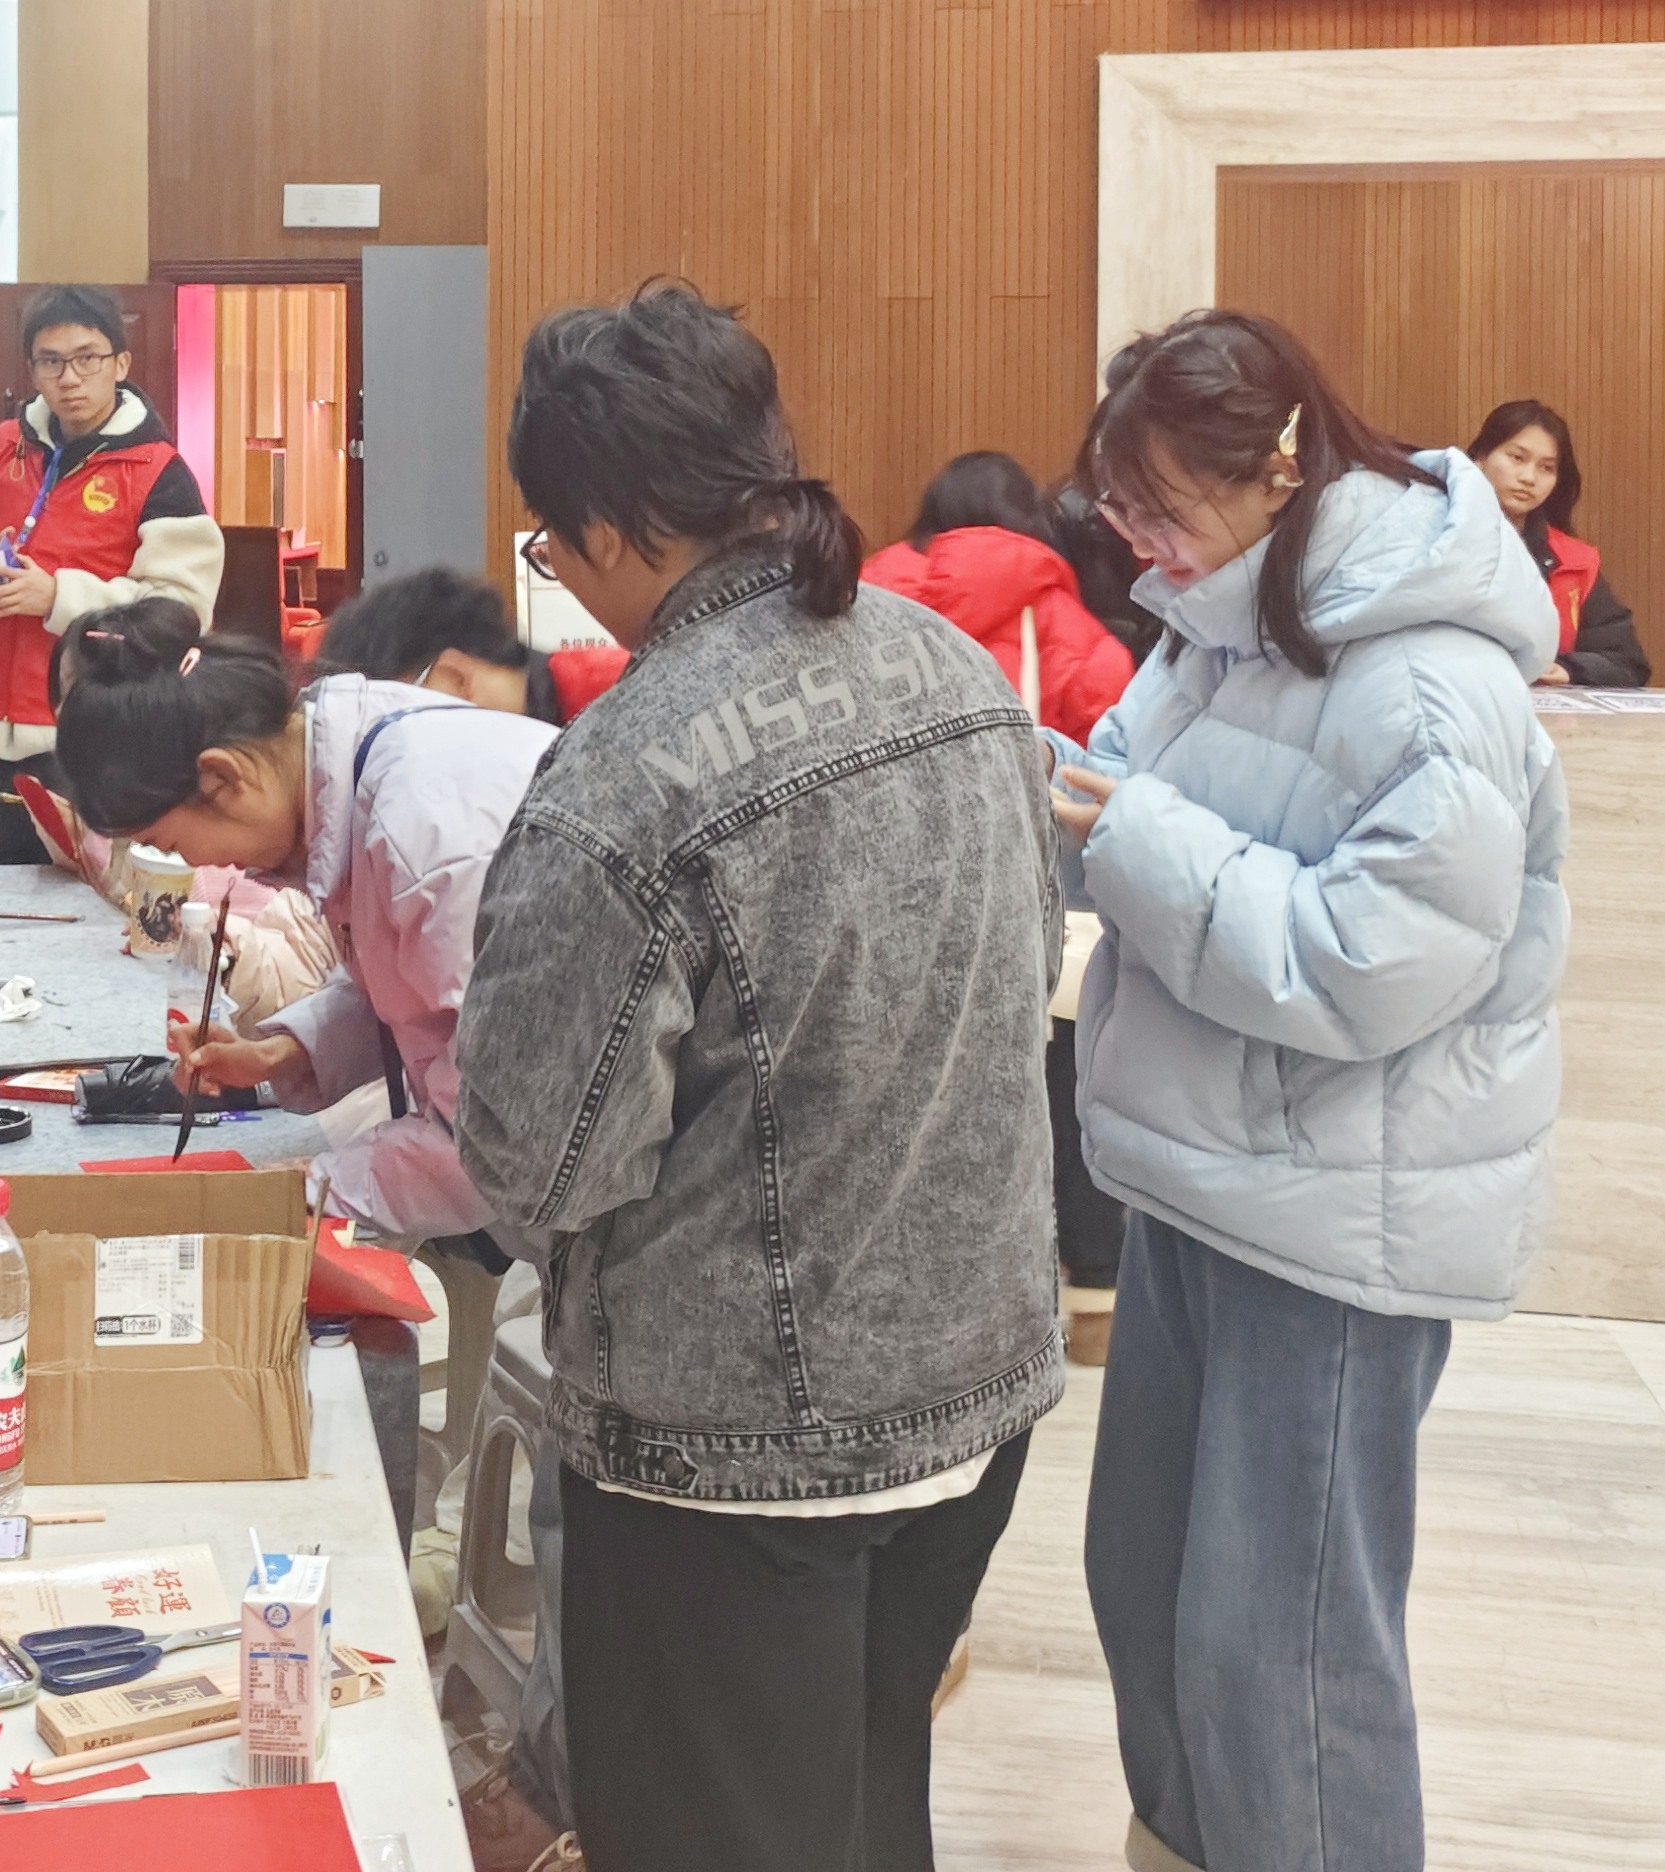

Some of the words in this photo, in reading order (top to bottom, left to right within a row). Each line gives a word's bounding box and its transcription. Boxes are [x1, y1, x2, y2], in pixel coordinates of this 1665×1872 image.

[637, 659, 857, 809] MISS
[152, 1567, 192, 1616] 好運
[135, 1685, 206, 1713] 原木
